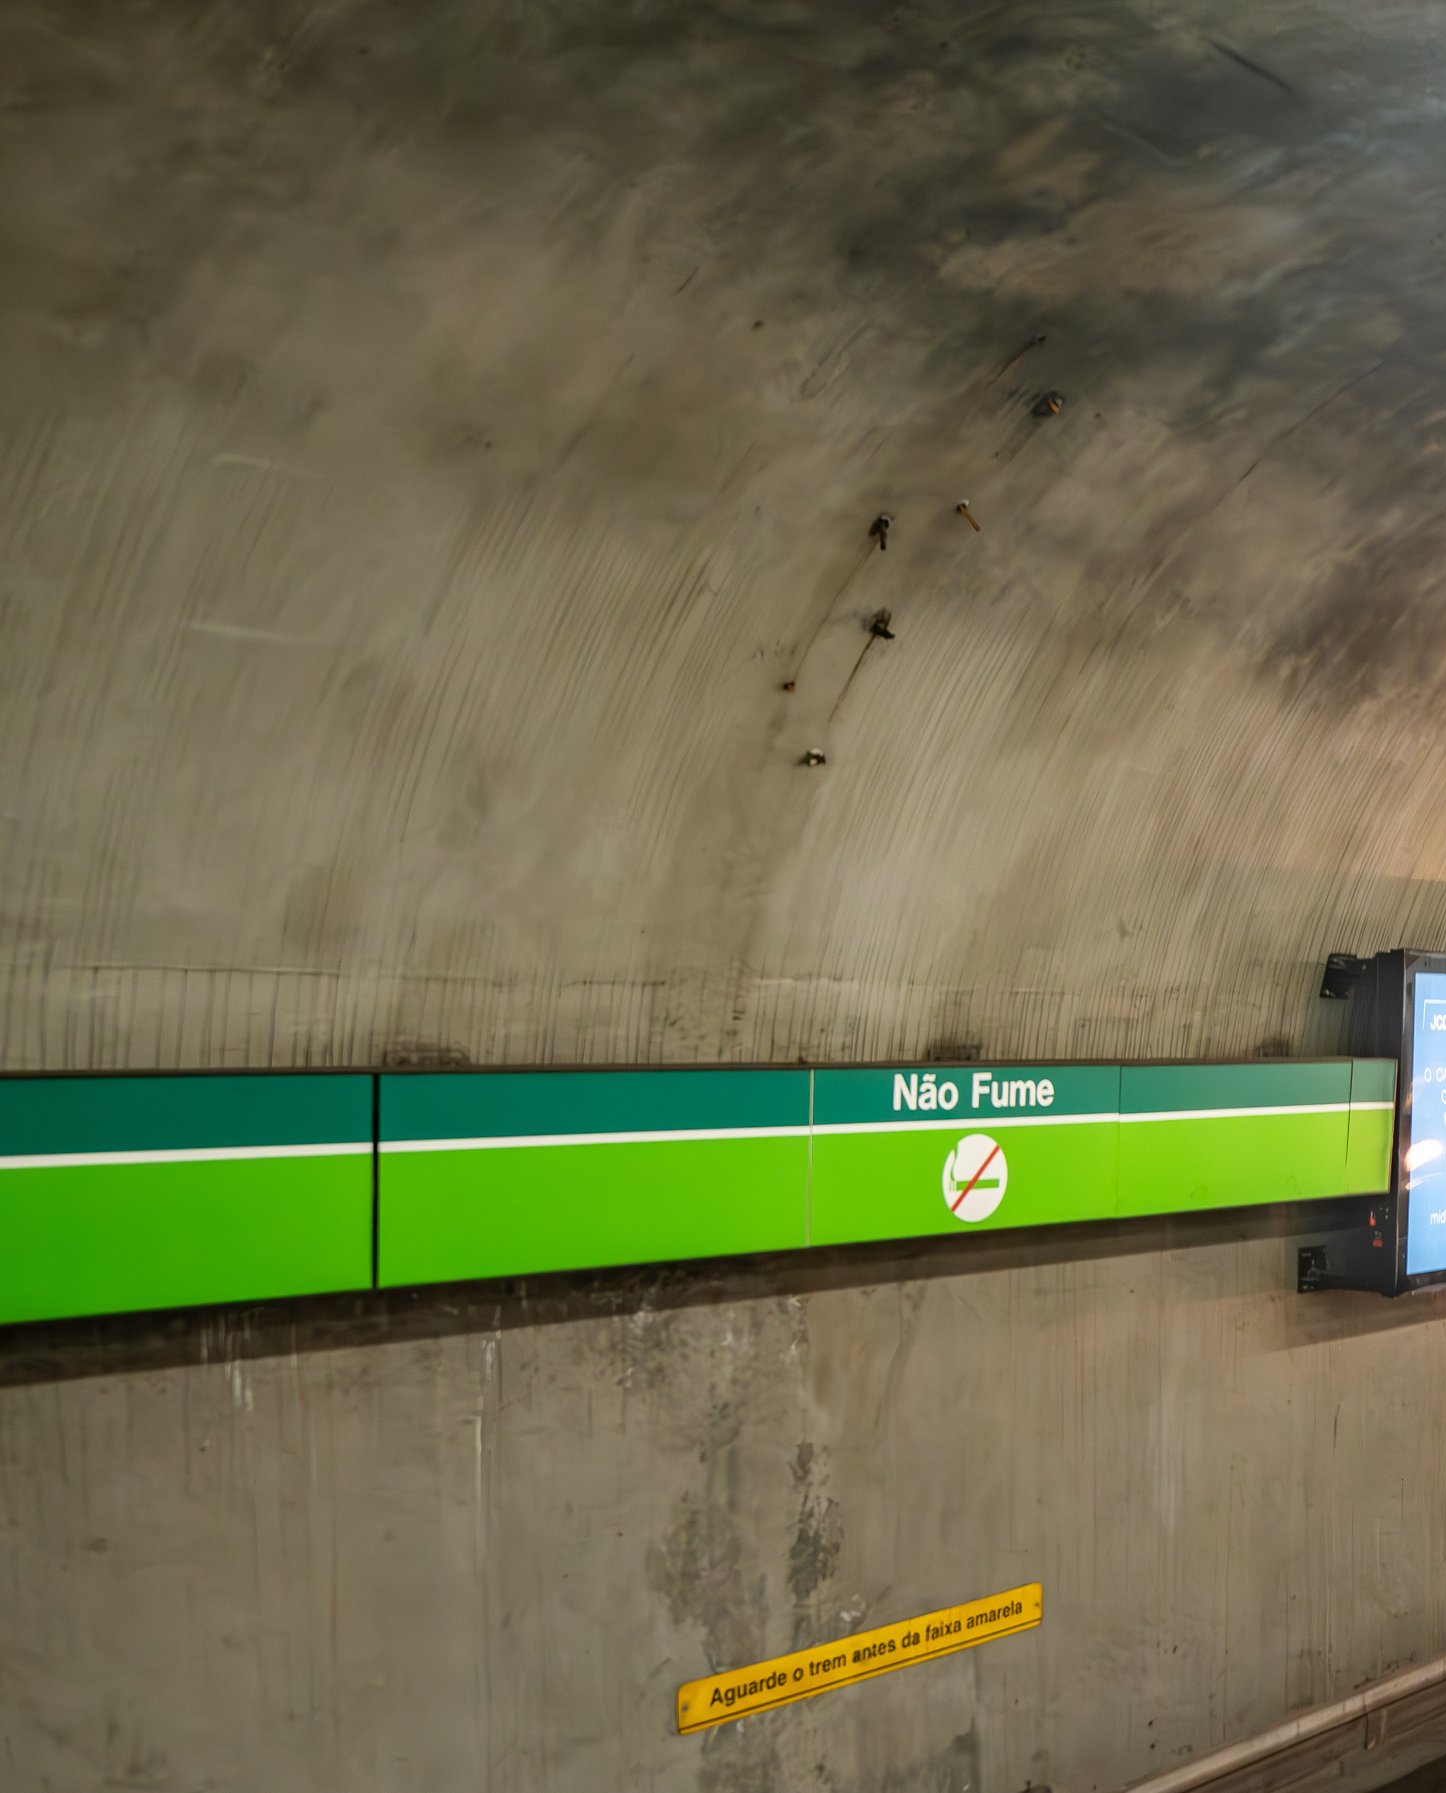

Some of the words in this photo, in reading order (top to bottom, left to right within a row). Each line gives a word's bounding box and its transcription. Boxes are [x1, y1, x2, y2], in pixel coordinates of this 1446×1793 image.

[892, 1073, 959, 1111] Não
[971, 1072, 1055, 1108] Fume
[1424, 1067, 1432, 1082] O
[710, 1671, 787, 1707] Aguarde
[793, 1668, 804, 1682] o
[809, 1654, 847, 1676] trem
[852, 1639, 896, 1663] antes
[901, 1631, 921, 1648] da
[925, 1620, 962, 1642] faixa
[966, 1600, 1023, 1629] amarela
